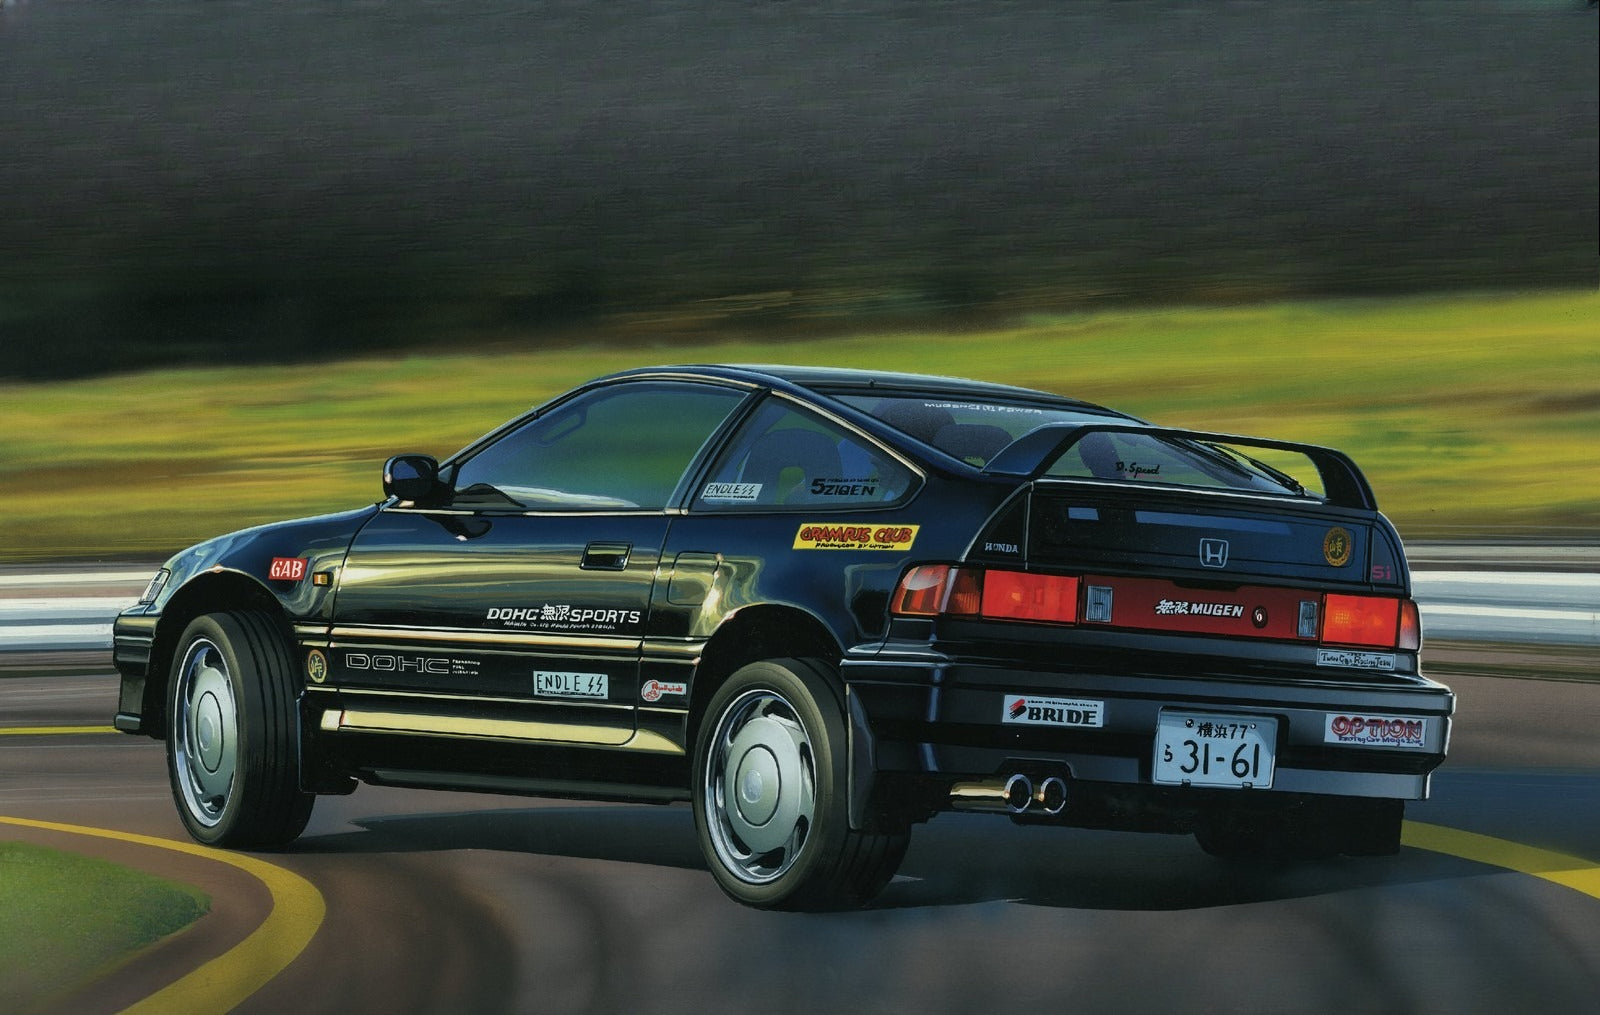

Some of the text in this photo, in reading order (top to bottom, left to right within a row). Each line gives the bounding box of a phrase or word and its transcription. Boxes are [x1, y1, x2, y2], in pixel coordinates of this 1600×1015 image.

[873, 527, 913, 544] CLUB
[984, 542, 1019, 553] HONDA
[271, 560, 303, 578] GAB
[1372, 564, 1392, 580] Si
[486, 607, 540, 621] DOHC
[569, 608, 641, 624] SPORTS
[1190, 603, 1244, 617] MUGEN
[346, 653, 450, 674] DOHC
[1027, 706, 1098, 726] BRIDE
[1331, 716, 1423, 740] OPTION
[1180, 739, 1261, 779] 31-61
